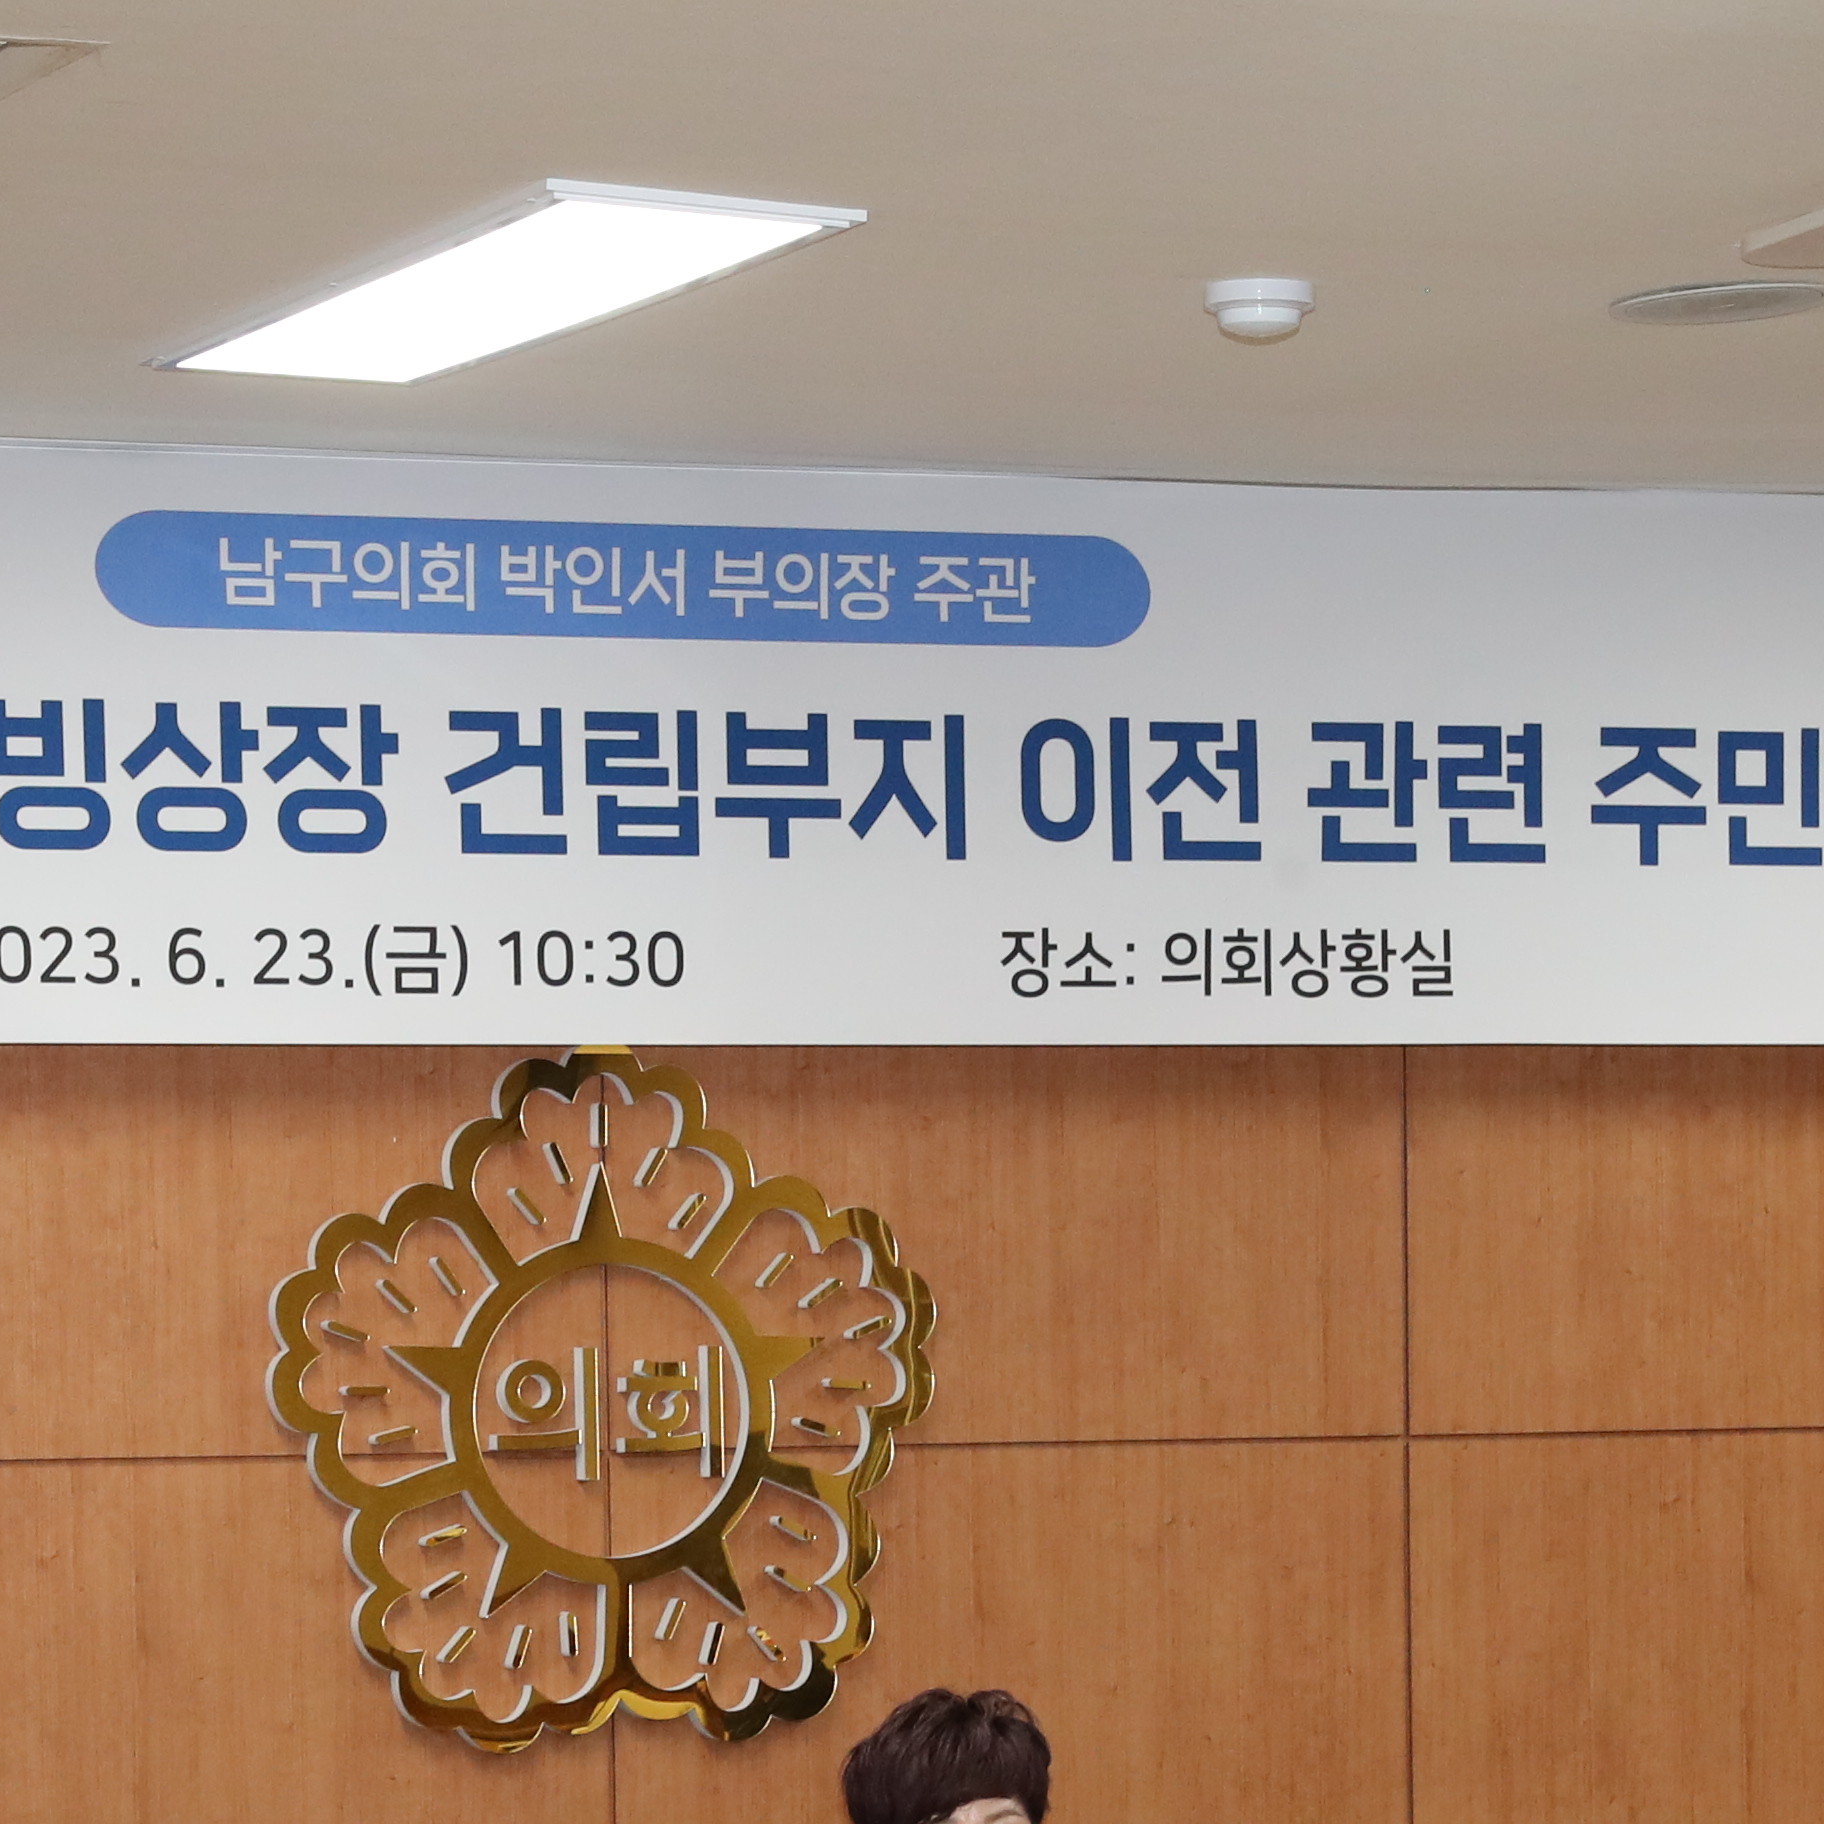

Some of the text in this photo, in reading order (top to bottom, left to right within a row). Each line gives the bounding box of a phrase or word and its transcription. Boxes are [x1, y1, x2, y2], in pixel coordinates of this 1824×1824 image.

[217, 537, 1036, 625] 남구의회 박인서 부의장 주관
[444, 707, 967, 862] 건립부지
[1020, 716, 1262, 863] 이전
[1307, 720, 1546, 865] 관련
[168, 927, 226, 989] 6.
[253, 924, 469, 997] 23.(금)
[498, 930, 685, 989] 10:30
[1000, 927, 1454, 999] 장소: 의회상황실
[489, 1345, 726, 1482] 의회
